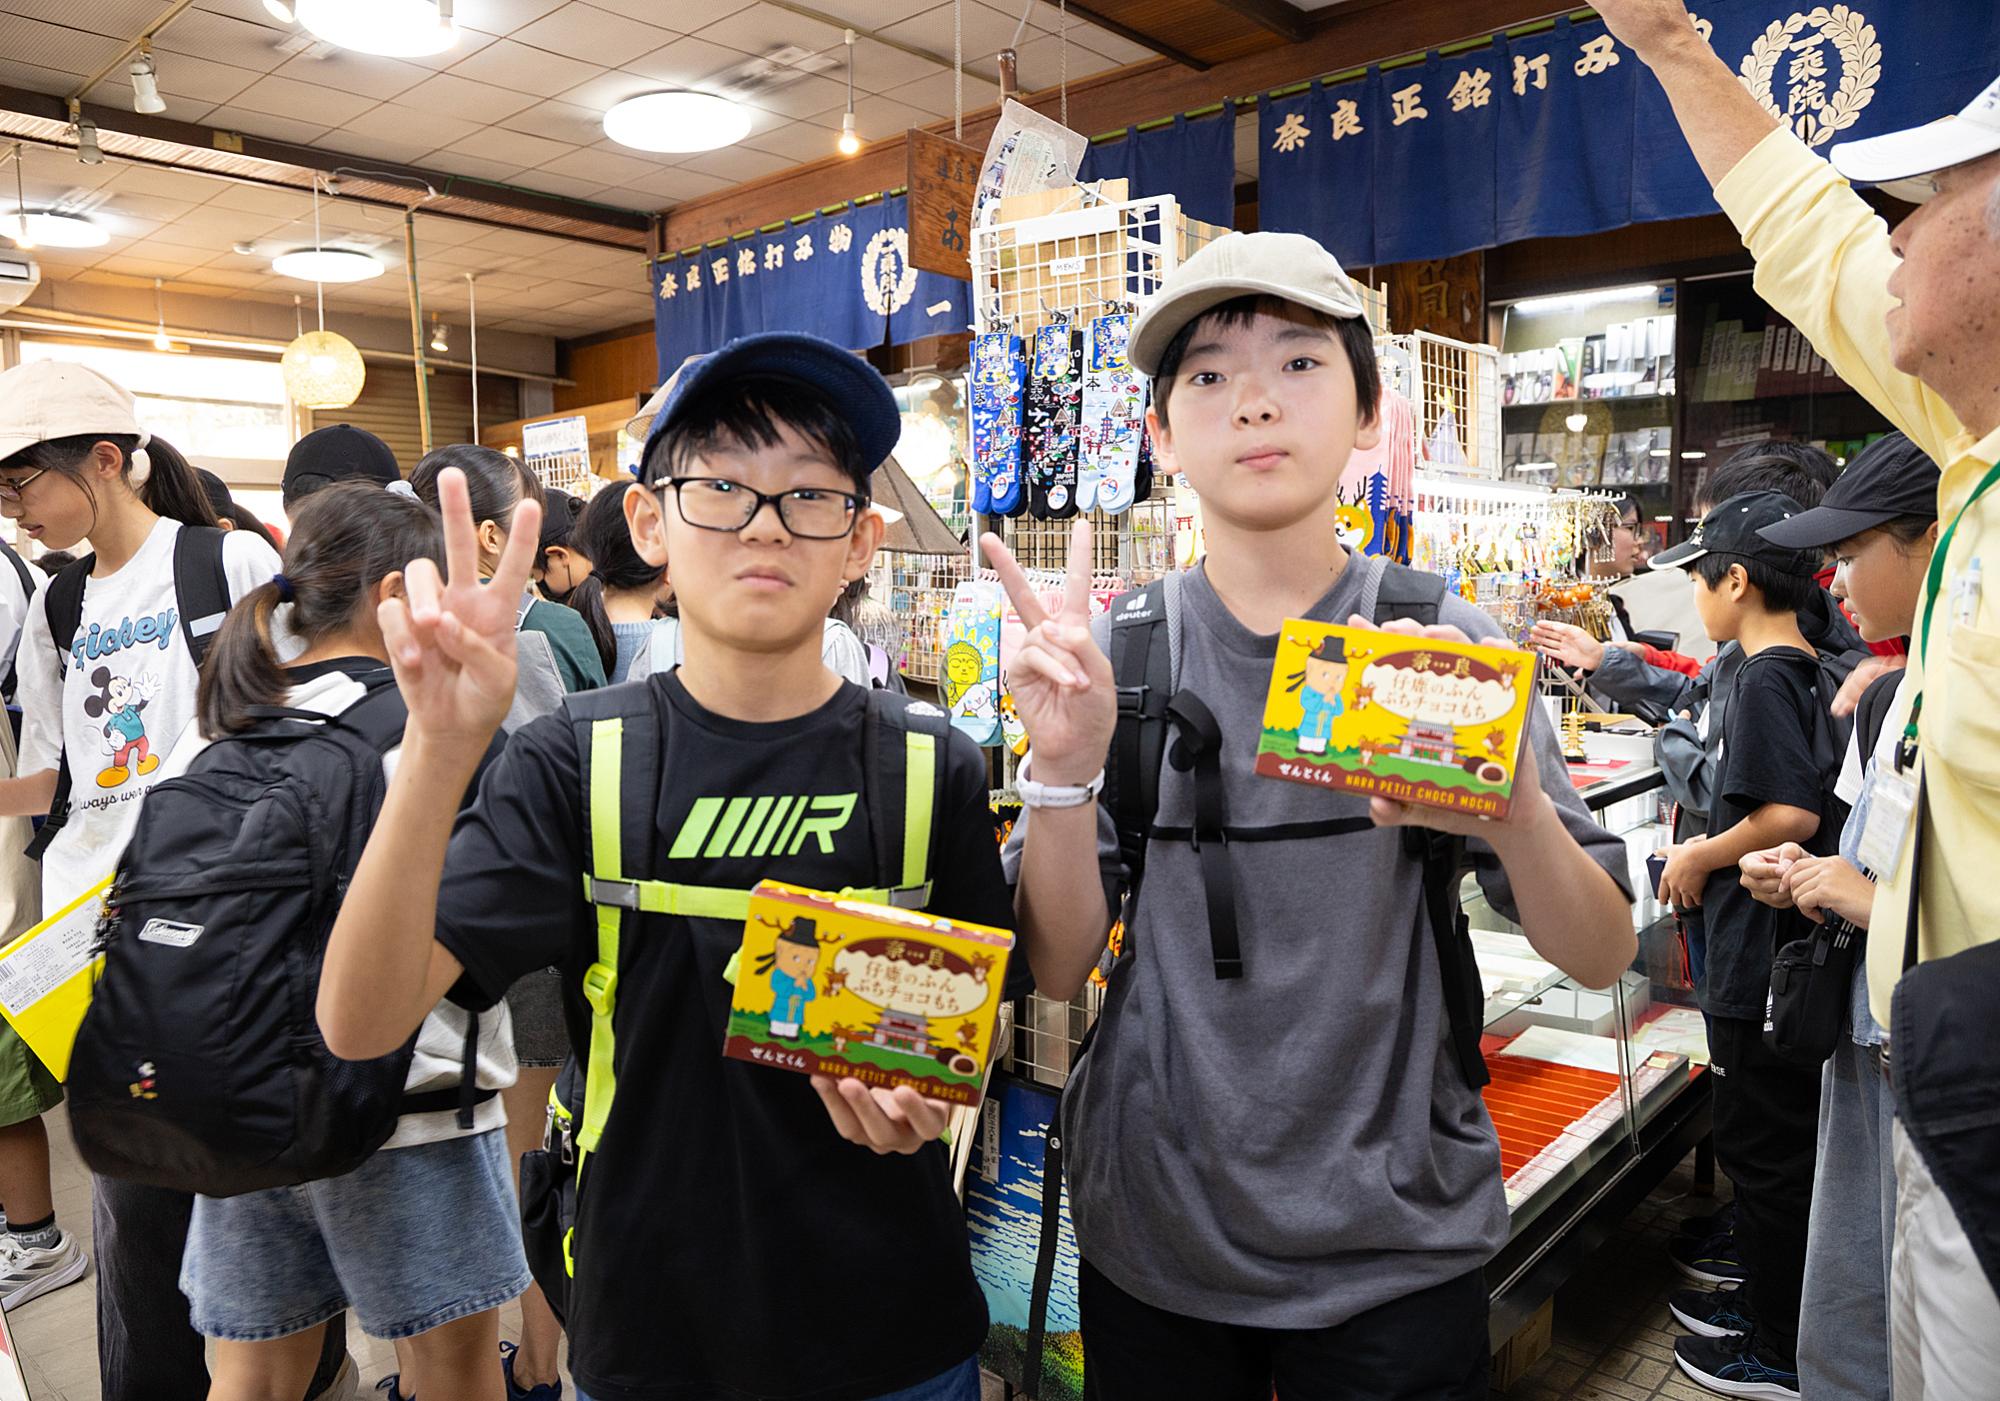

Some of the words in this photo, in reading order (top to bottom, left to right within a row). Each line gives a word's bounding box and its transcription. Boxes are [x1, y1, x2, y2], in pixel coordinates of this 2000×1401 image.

[1116, 610, 1153, 622] deuter
[1278, 762, 1333, 784] せんとくん
[1345, 774, 1375, 790] NARA
[1379, 780, 1412, 798] PETIT
[1416, 787, 1455, 804] CHOCO
[1460, 795, 1497, 812] MOCHI
[750, 1047, 806, 1069] せんとくん
[818, 1060, 849, 1076] NARA
[853, 1067, 886, 1084] PETIT
[933, 1083, 969, 1101] MOCHI
